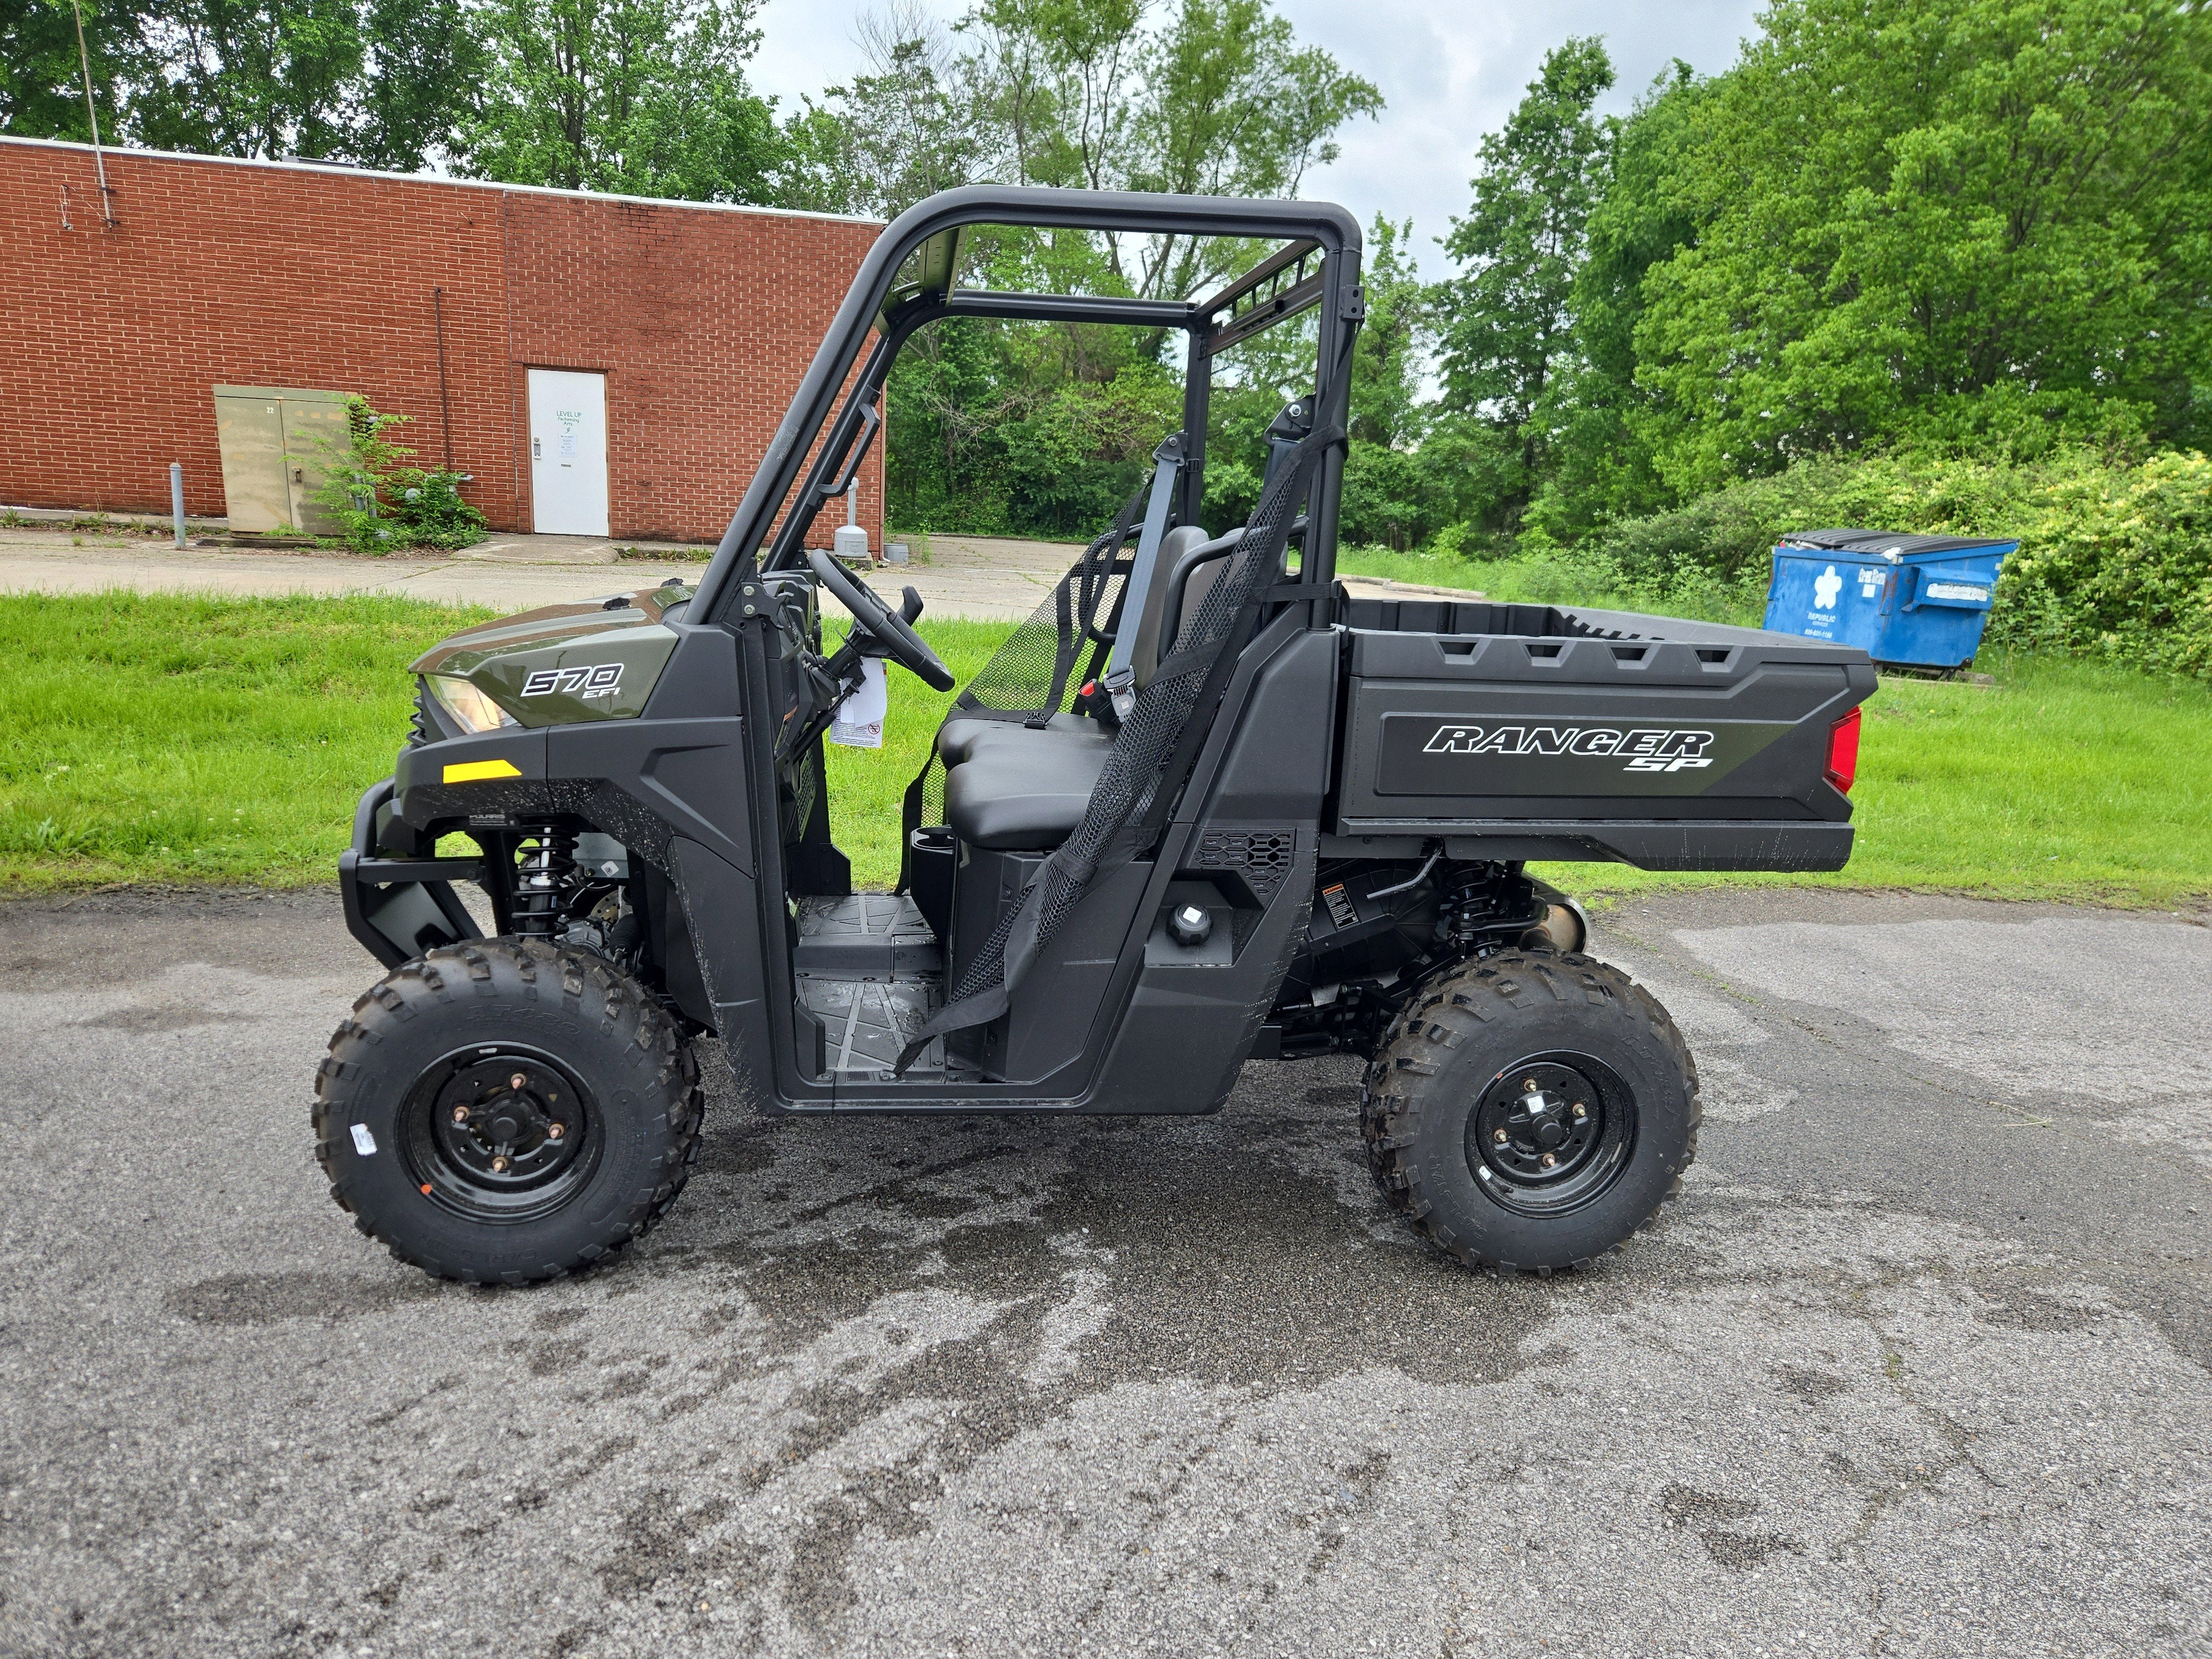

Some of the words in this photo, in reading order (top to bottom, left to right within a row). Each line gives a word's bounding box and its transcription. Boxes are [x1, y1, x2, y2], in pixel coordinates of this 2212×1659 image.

[1807, 612, 1836, 623] REPUBLIC
[520, 663, 624, 697] 570
[582, 687, 620, 699] EFI
[1422, 725, 1715, 757] RANGER
[1623, 757, 1714, 772] SP
